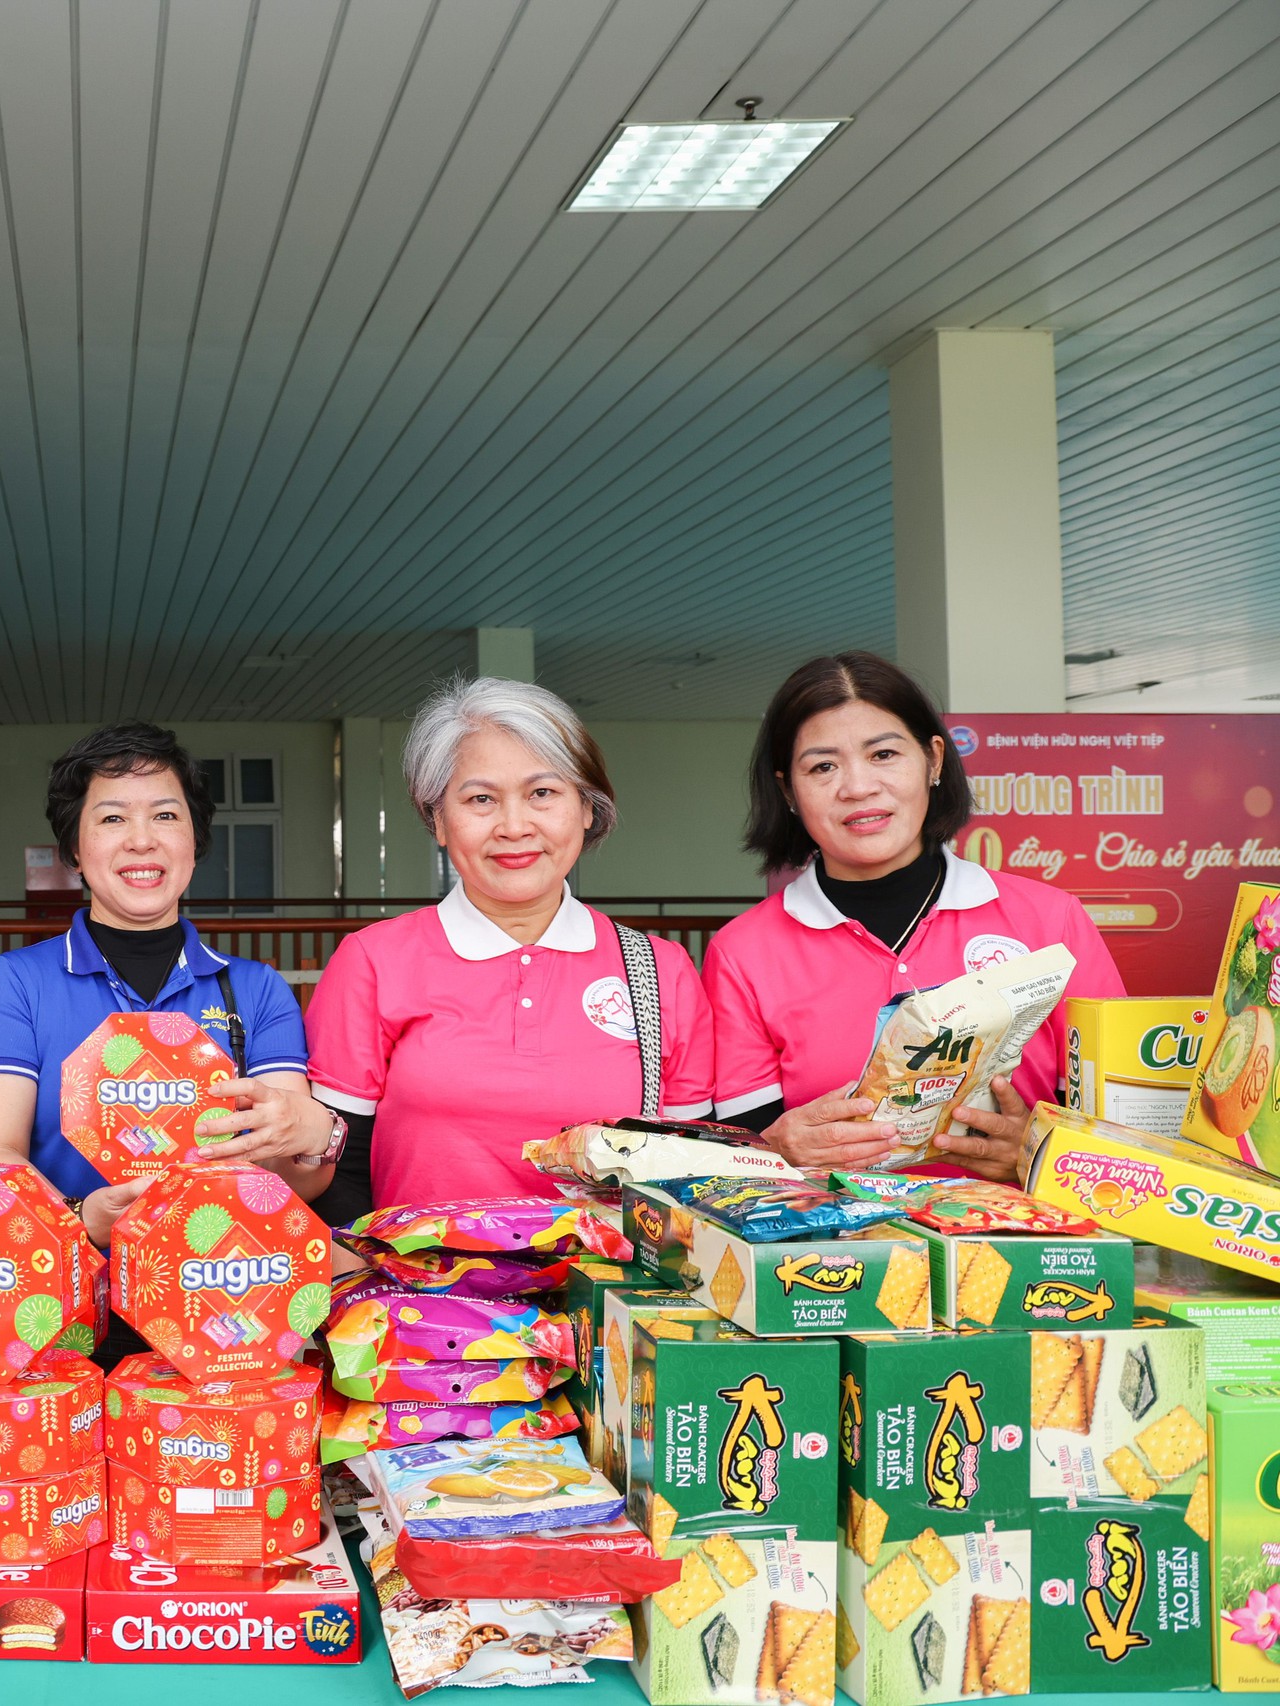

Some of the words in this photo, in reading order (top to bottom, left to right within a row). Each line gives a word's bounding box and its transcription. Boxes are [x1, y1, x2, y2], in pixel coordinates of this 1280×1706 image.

[986, 734, 1019, 750] BỆNH
[1021, 734, 1049, 750] VIỆN
[1079, 735, 1112, 750] NGHỊ
[1114, 733, 1140, 749] VIỆT
[1141, 733, 1165, 749] TIẾP
[972, 772, 1072, 815] HƯƠNG
[1078, 765, 1164, 815] TRÌNH
[1008, 836, 1067, 880] đồng
[1095, 831, 1157, 871] Chia
[1161, 840, 1188, 868] sẻ
[1183, 841, 1234, 880] yêu
[1108, 910, 1135, 921] 2026
[938, 1004, 966, 1023] ORION
[903, 1025, 975, 1071] An
[97, 1079, 199, 1117] sugus
[919, 1077, 958, 1093] 100%
[130, 1160, 163, 1169] FESTIVE
[733, 1155, 773, 1168] ORION
[1057, 1157, 1106, 1181] Kem
[1108, 1166, 1163, 1192] Nhân
[1041, 1253, 1068, 1268] BIỂN
[1043, 1246, 1070, 1254] Crackers
[1069, 1253, 1097, 1266] TẢO
[1214, 1238, 1266, 1260] ORION
[71, 1240, 80, 1309] sugus
[119, 1242, 129, 1312] sugus
[179, 1251, 293, 1296] sugus
[774, 1252, 865, 1298] Kami
[1043, 1266, 1076, 1275] CRACKERS
[1077, 1267, 1096, 1276] BÁNH
[345, 1283, 404, 1305] PLUM
[817, 1298, 845, 1306] CRACKERS
[1023, 1278, 1116, 1323] Kami
[1187, 1306, 1212, 1318] Bánh
[1214, 1306, 1247, 1318] Custas
[1248, 1305, 1269, 1317] Kem
[792, 1307, 818, 1320] TẢO
[820, 1305, 847, 1320] BIỂN
[794, 1319, 820, 1328] Seaweed
[820, 1319, 844, 1327] Crackers
[205, 1359, 264, 1375] COLLECTION
[217, 1352, 254, 1364] FESTIVE
[70, 1401, 103, 1435] sugus
[665, 1406, 676, 1443] Seaweed
[676, 1401, 693, 1444] TẢO
[698, 1405, 708, 1429] BÁNH
[876, 1410, 887, 1448] Seaweed
[886, 1403, 903, 1447] TẢO
[906, 1406, 916, 1431] BÁNH
[159, 1434, 230, 1460] sugus
[697, 1430, 707, 1485] CRACKERS
[717, 1371, 786, 1516] Kami
[905, 1433, 915, 1486] CRACKERS
[923, 1370, 985, 1513] Kami
[664, 1444, 675, 1484] Crackers
[675, 1446, 697, 1488] BIỂN
[875, 1449, 886, 1488] Crackers
[885, 1449, 907, 1491] BIỂN
[50, 1491, 102, 1529] sugus
[1157, 1549, 1167, 1599] CRACKERS
[1167, 1547, 1188, 1588] BIỂN
[1189, 1551, 1200, 1590] Crackers
[183, 1602, 243, 1616] ORION
[1083, 1519, 1152, 1663] Kami
[1189, 1590, 1201, 1628] Seaweed
[298, 1610, 350, 1646] Tình
[1158, 1600, 1168, 1630] BÁNH
[1173, 1590, 1190, 1633] TẢO
[112, 1616, 296, 1651] ChocoPie
